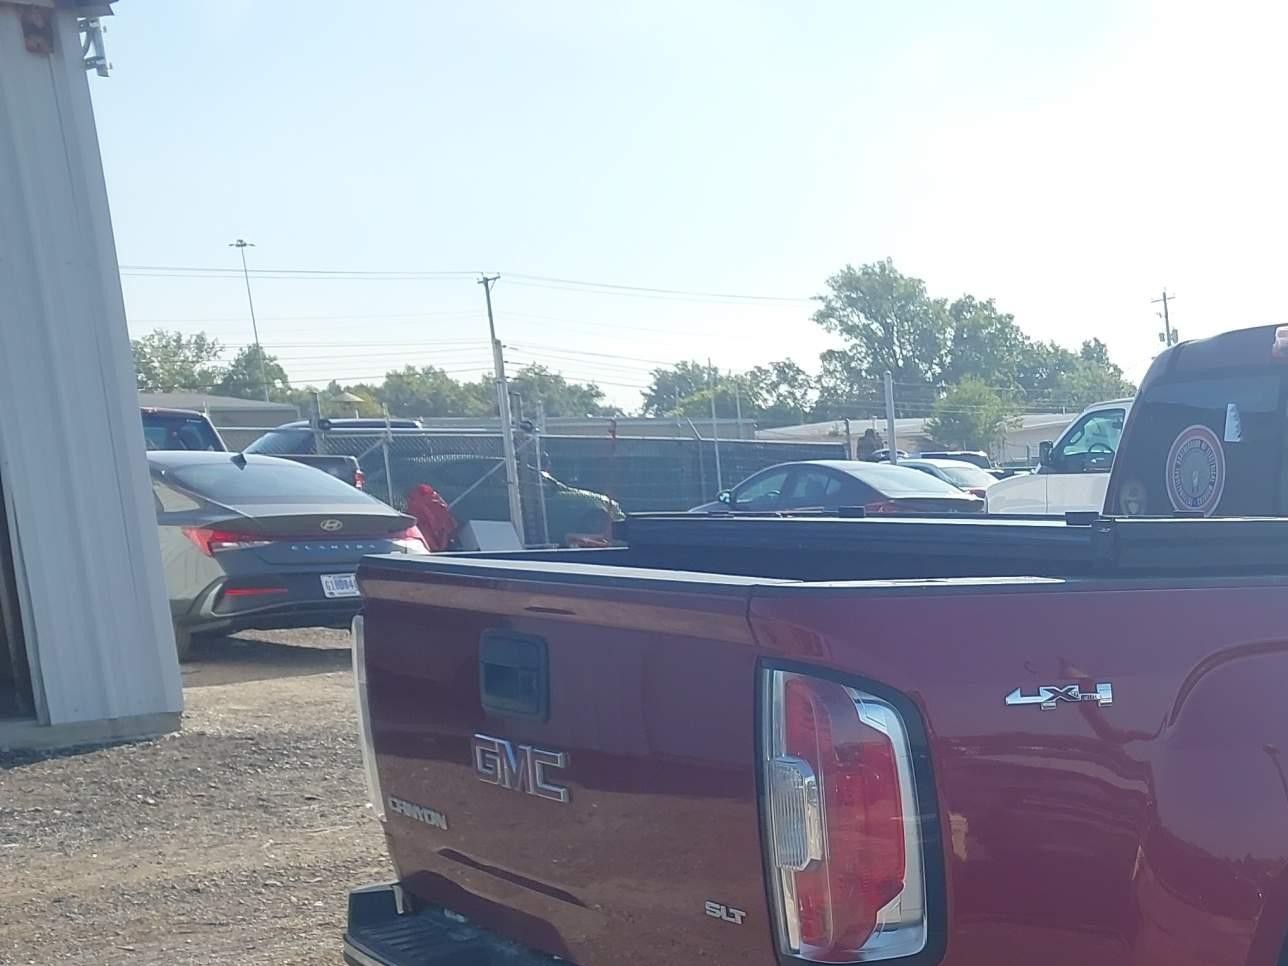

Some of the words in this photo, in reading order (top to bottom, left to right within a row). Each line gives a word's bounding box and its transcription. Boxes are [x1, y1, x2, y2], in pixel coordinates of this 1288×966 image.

[472, 733, 572, 803] GMC
[389, 797, 448, 831] CANYON
[704, 900, 747, 925] SLT
